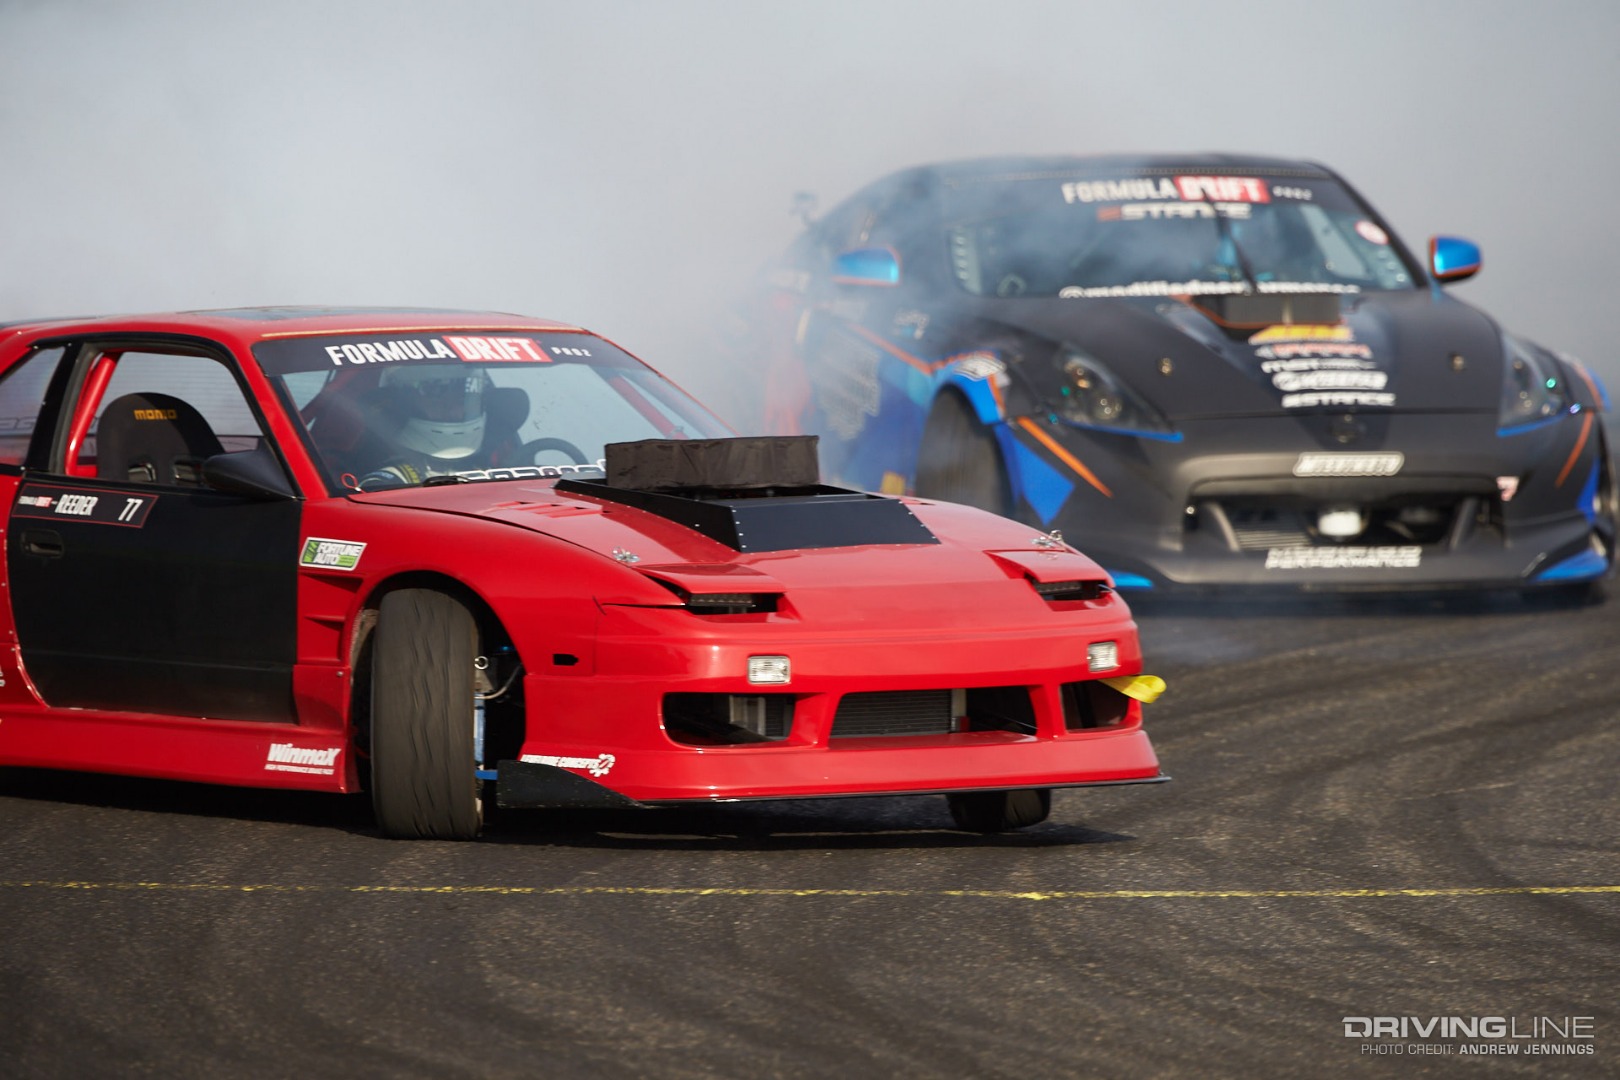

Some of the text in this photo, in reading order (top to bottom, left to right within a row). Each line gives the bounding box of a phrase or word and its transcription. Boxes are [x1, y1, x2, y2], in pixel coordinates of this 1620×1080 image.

[1062, 178, 1177, 204] FORMULA
[1178, 176, 1262, 202] DRIFT
[324, 339, 458, 366] FORMULA
[447, 336, 543, 361] DRIFT
[55, 494, 99, 516] REEDER
[118, 498, 143, 522] 77
[313, 553, 340, 566] AUTO
[317, 542, 362, 557] FORTUNE
